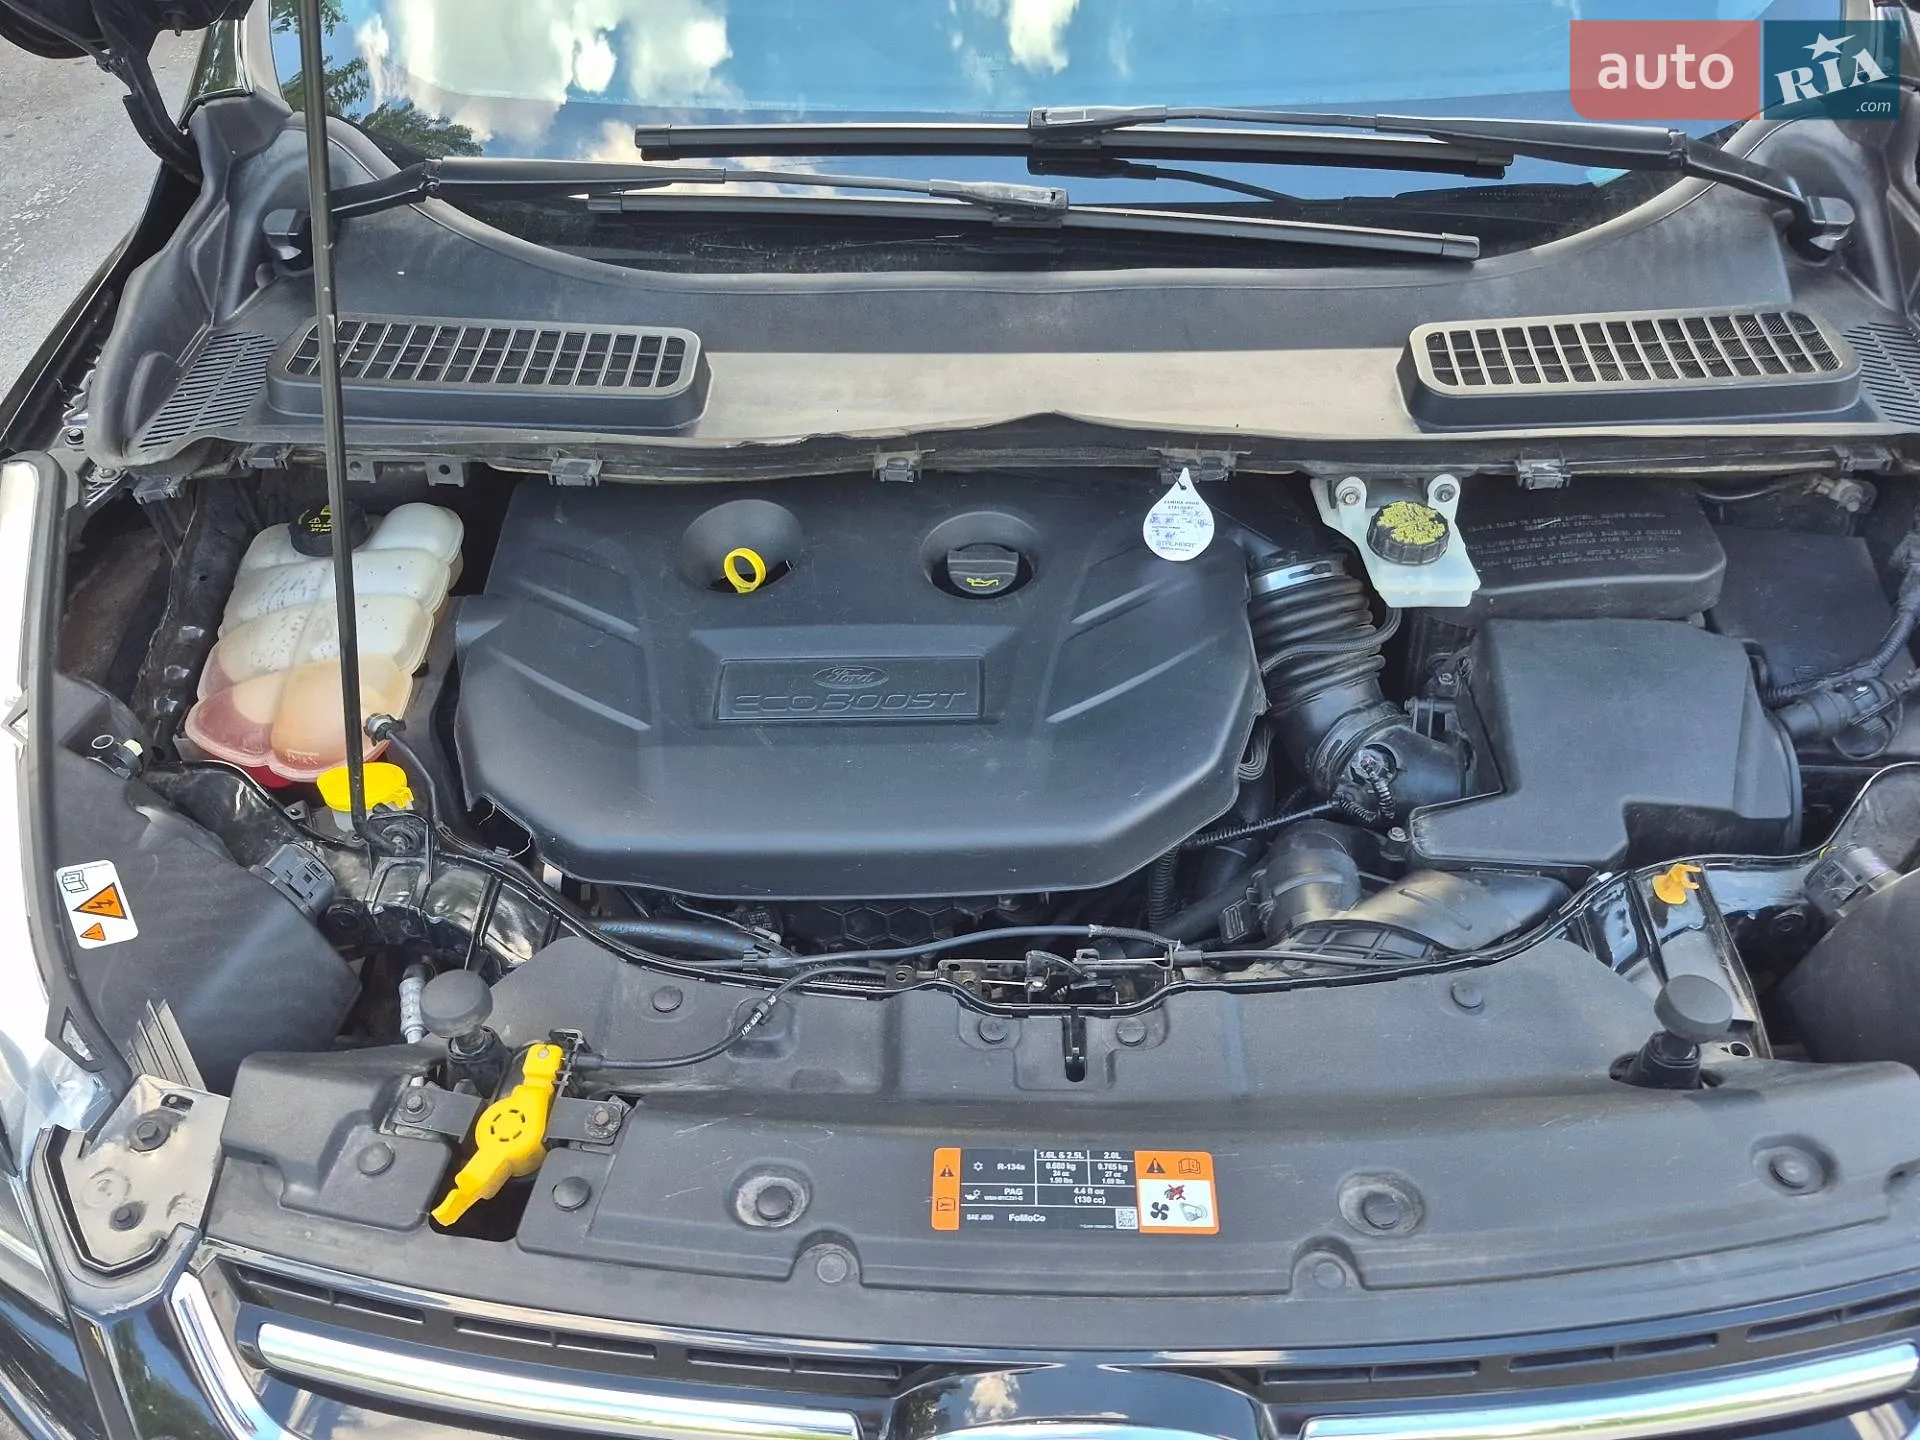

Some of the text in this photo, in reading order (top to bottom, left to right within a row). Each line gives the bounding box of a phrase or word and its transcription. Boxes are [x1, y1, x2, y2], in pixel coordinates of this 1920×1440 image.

[827, 664, 876, 685] Ford
[731, 692, 967, 714] ECOBOOST
[1066, 1151, 1085, 1159] 2.5L
[1104, 1152, 1122, 1160] 2.0L
[996, 1162, 1026, 1171] R-134a
[1066, 1162, 1076, 1172] kg
[1118, 1163, 1128, 1172] kg
[1004, 1187, 1024, 1196] PAG
[1074, 1187, 1087, 1195] 4.4
[1074, 1195, 1106, 1205] (130 cc)
[1008, 1213, 1046, 1222] FoMoCo
